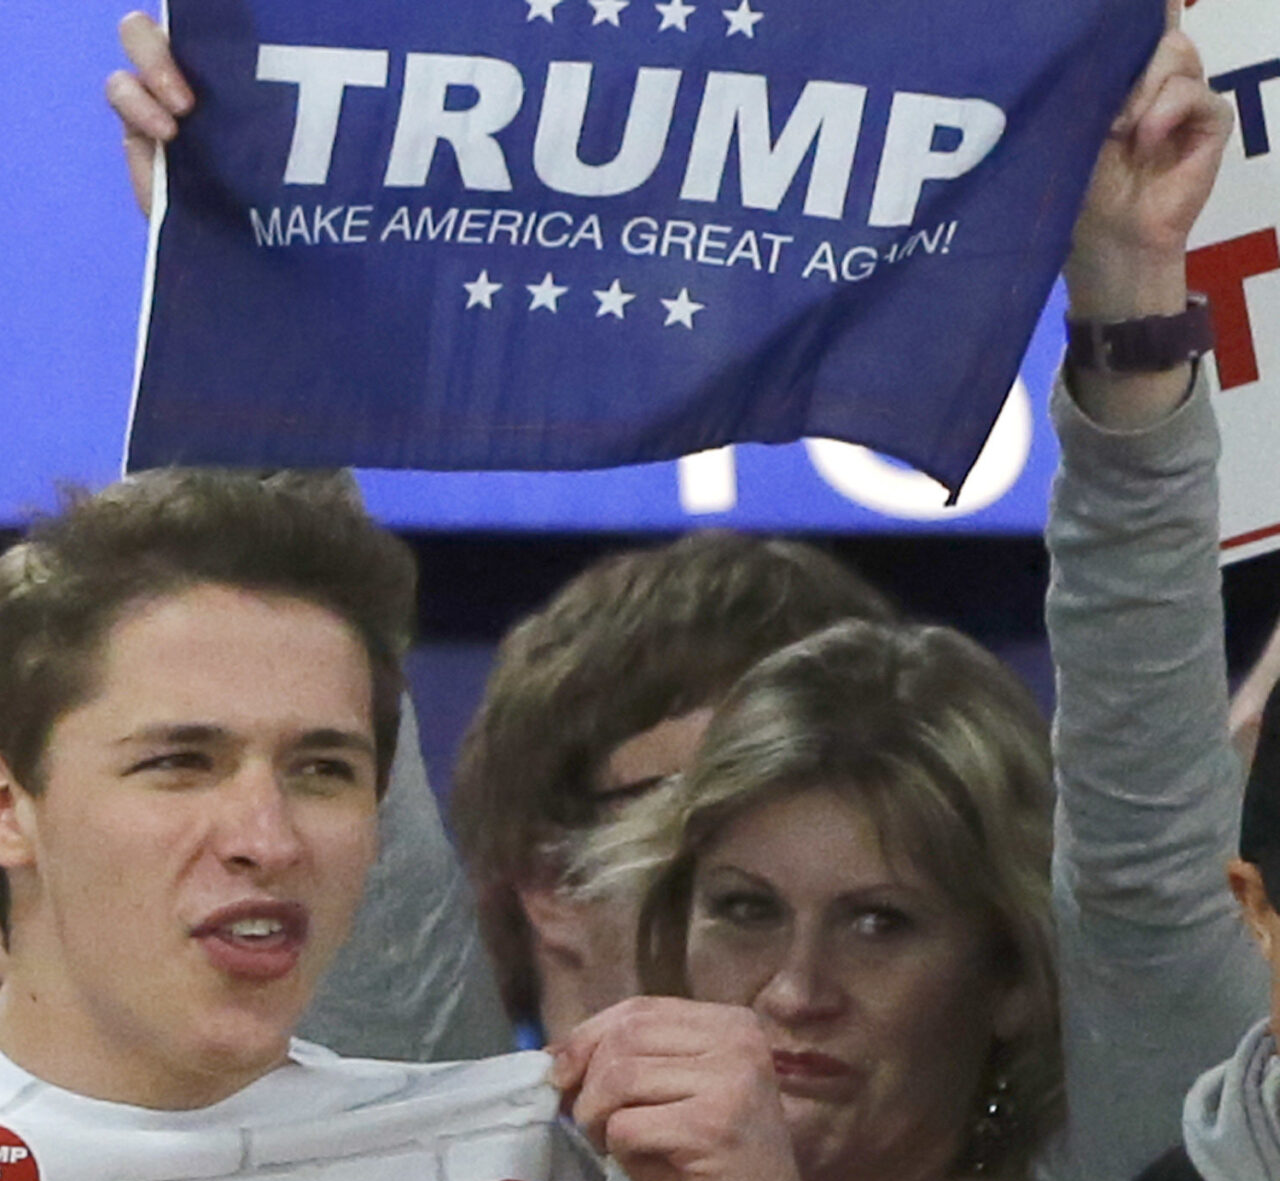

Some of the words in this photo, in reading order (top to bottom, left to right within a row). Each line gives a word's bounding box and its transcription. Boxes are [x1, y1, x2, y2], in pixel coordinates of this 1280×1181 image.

[254, 43, 1007, 228] TRUMP
[249, 204, 374, 247] MAKE
[379, 205, 604, 251] AMERICA
[620, 216, 795, 274] GREAT
